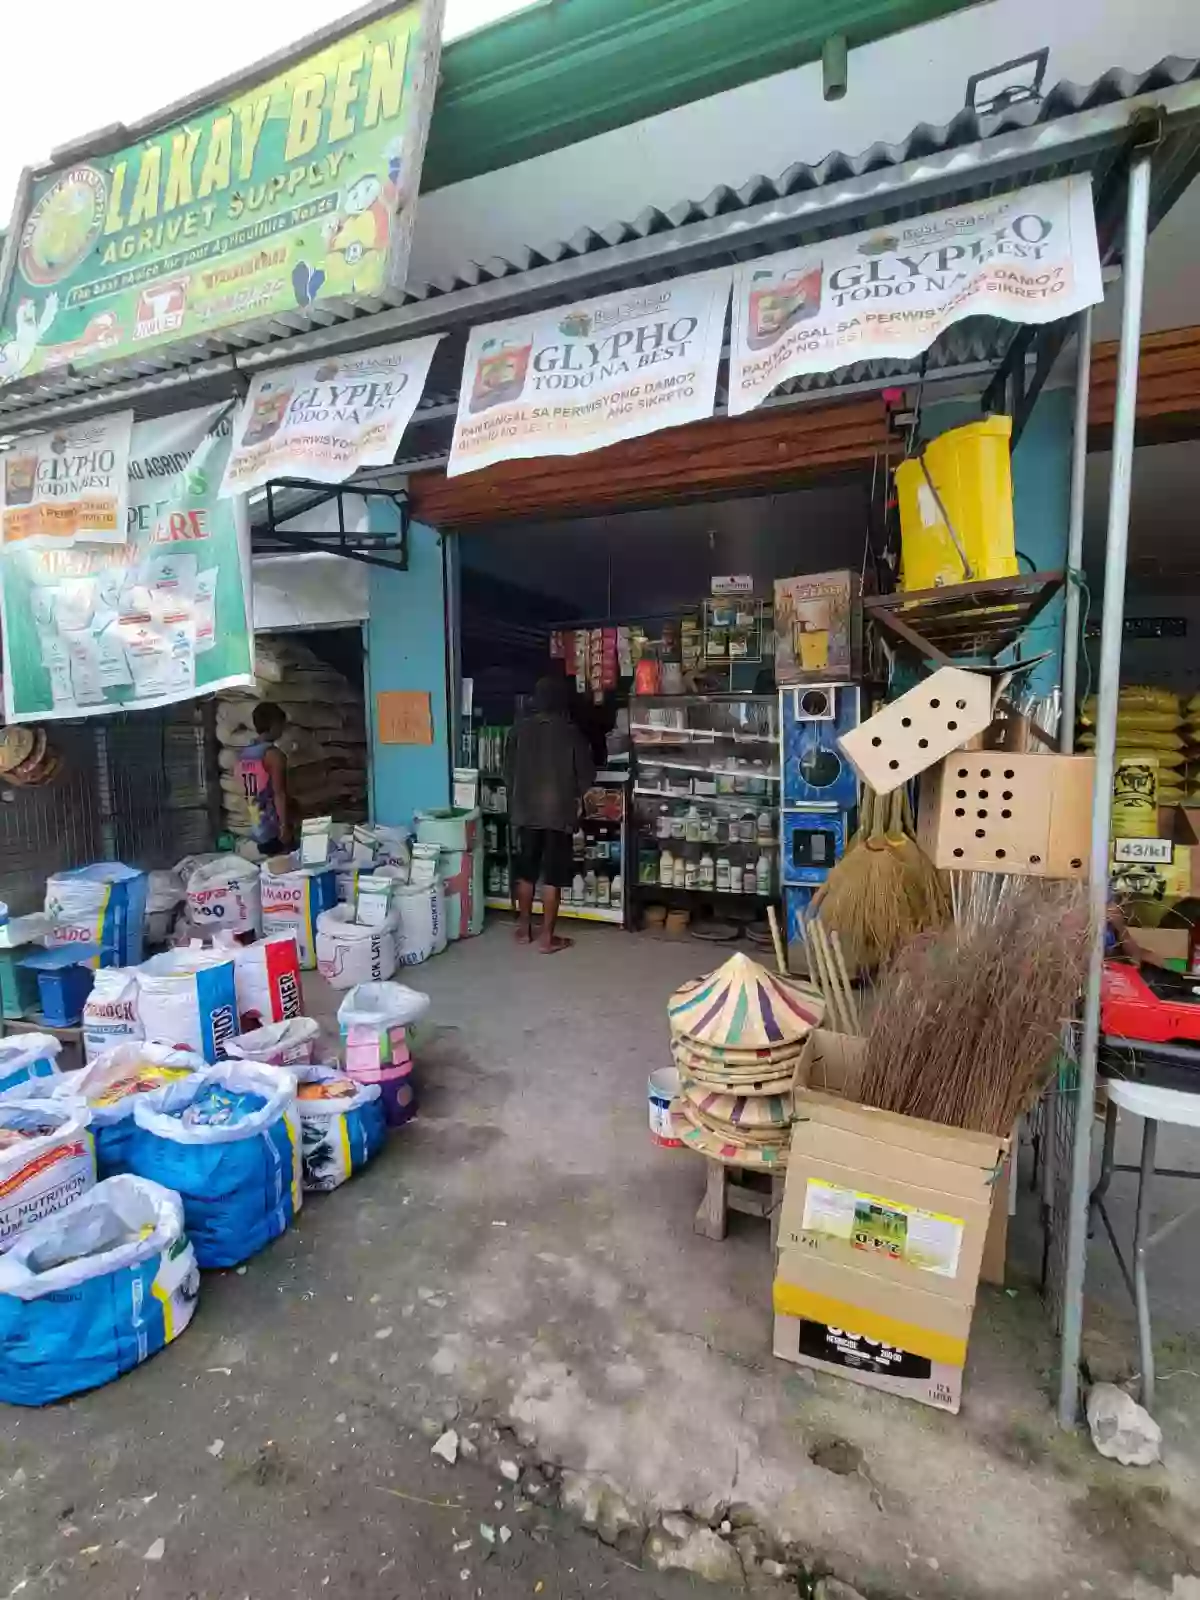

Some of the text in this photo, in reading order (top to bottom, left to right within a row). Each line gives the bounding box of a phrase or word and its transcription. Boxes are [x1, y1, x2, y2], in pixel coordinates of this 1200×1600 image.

[104, 95, 271, 236] LAKAY
[284, 29, 411, 163] BEN
[101, 202, 217, 267] AGRIVET
[227, 150, 346, 221] SUPPLY
[832, 280, 915, 307] TODO
[986, 281, 1066, 299] SIKRETO
[836, 318, 860, 333] SA
[533, 316, 699, 373] GLYPHO
[532, 341, 693, 391] TODO NA BEST
[532, 407, 551, 419] SA
[553, 386, 641, 418] PERWISYONG
[645, 371, 697, 394] DAMO?
[333, 408, 361, 425] NA
[36, 450, 116, 484] GLYPHO
[19, 1175, 86, 1215] NUTRITION
[28, 1190, 82, 1223] QUALITY
